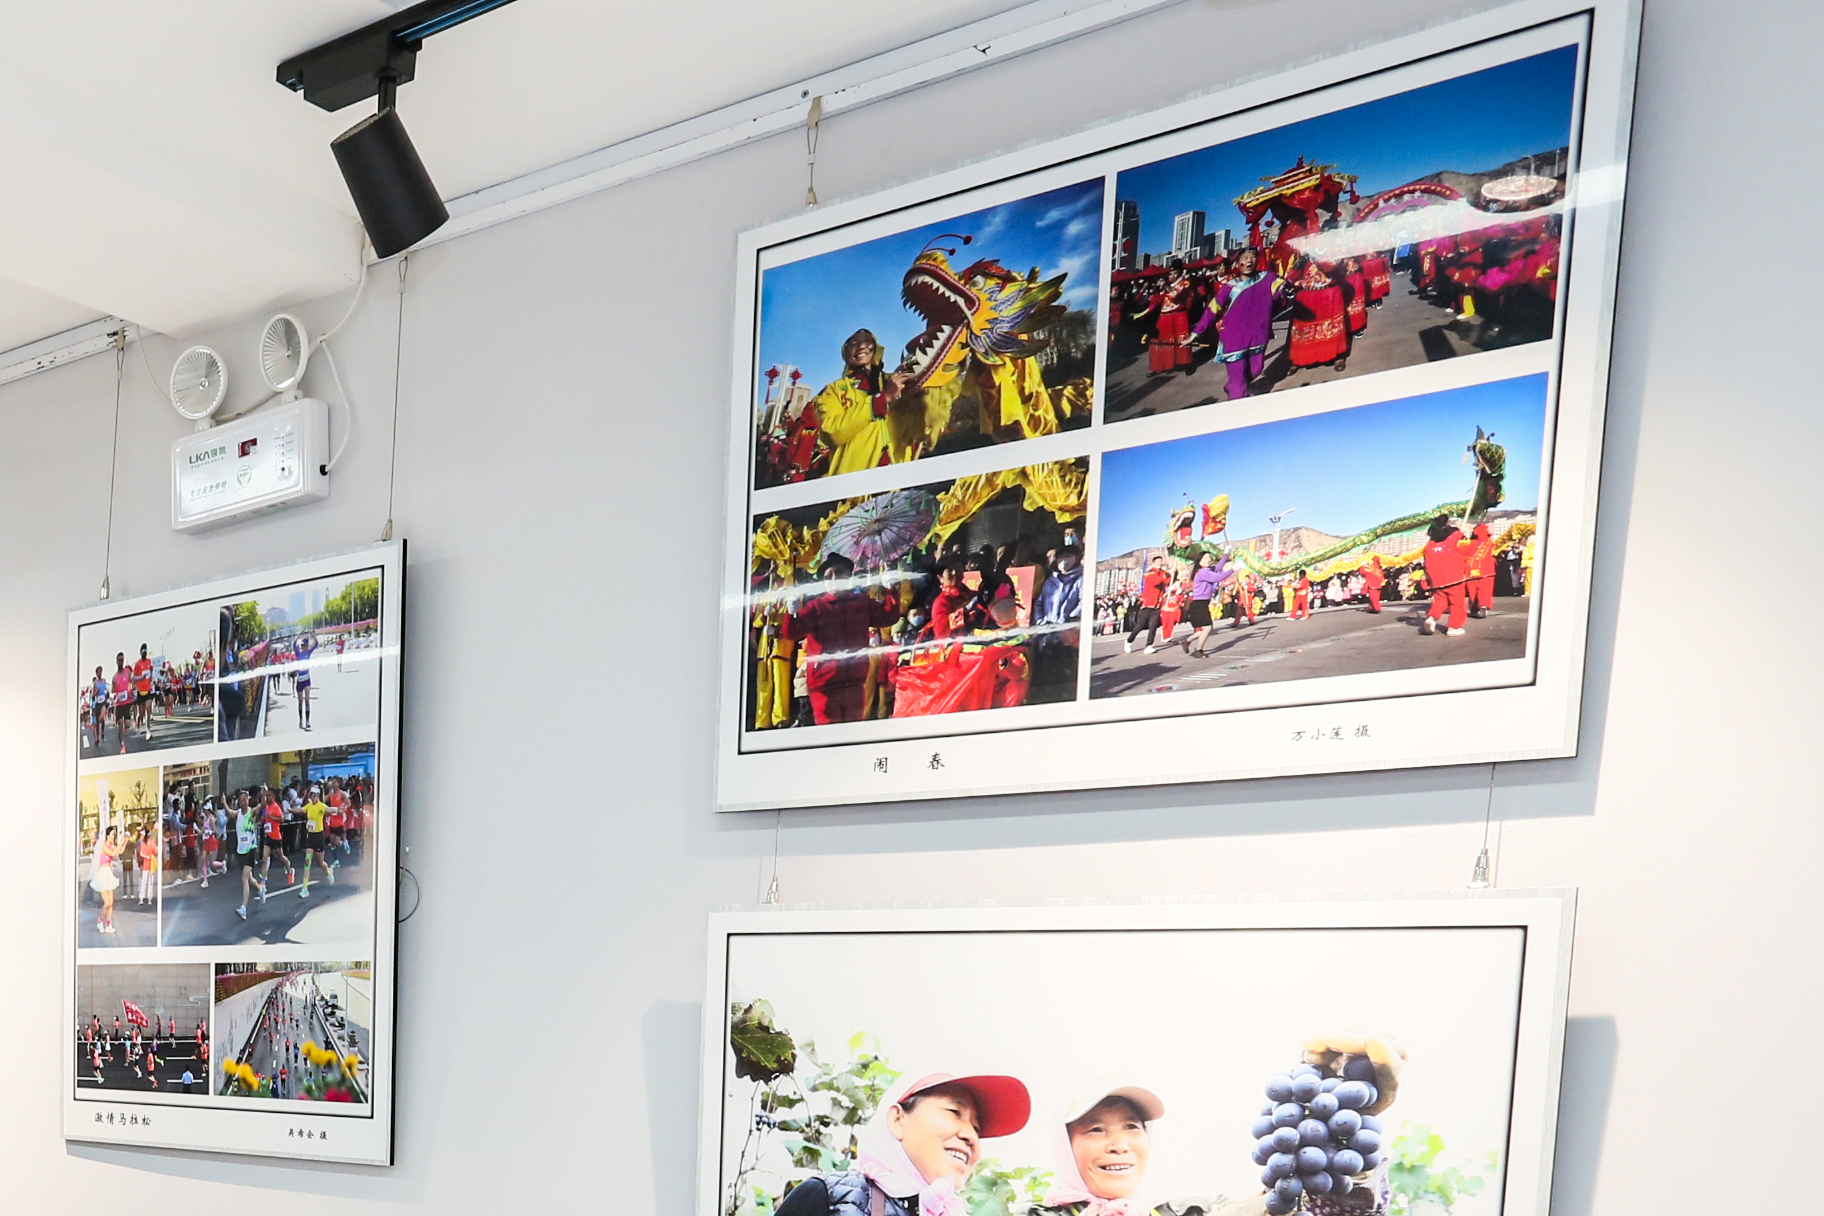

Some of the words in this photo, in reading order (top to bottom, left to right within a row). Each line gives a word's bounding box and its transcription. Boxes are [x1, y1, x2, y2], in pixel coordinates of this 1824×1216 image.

[1354, 723, 1371, 738] 摄
[94, 1110, 152, 1126] 激情马拉松
